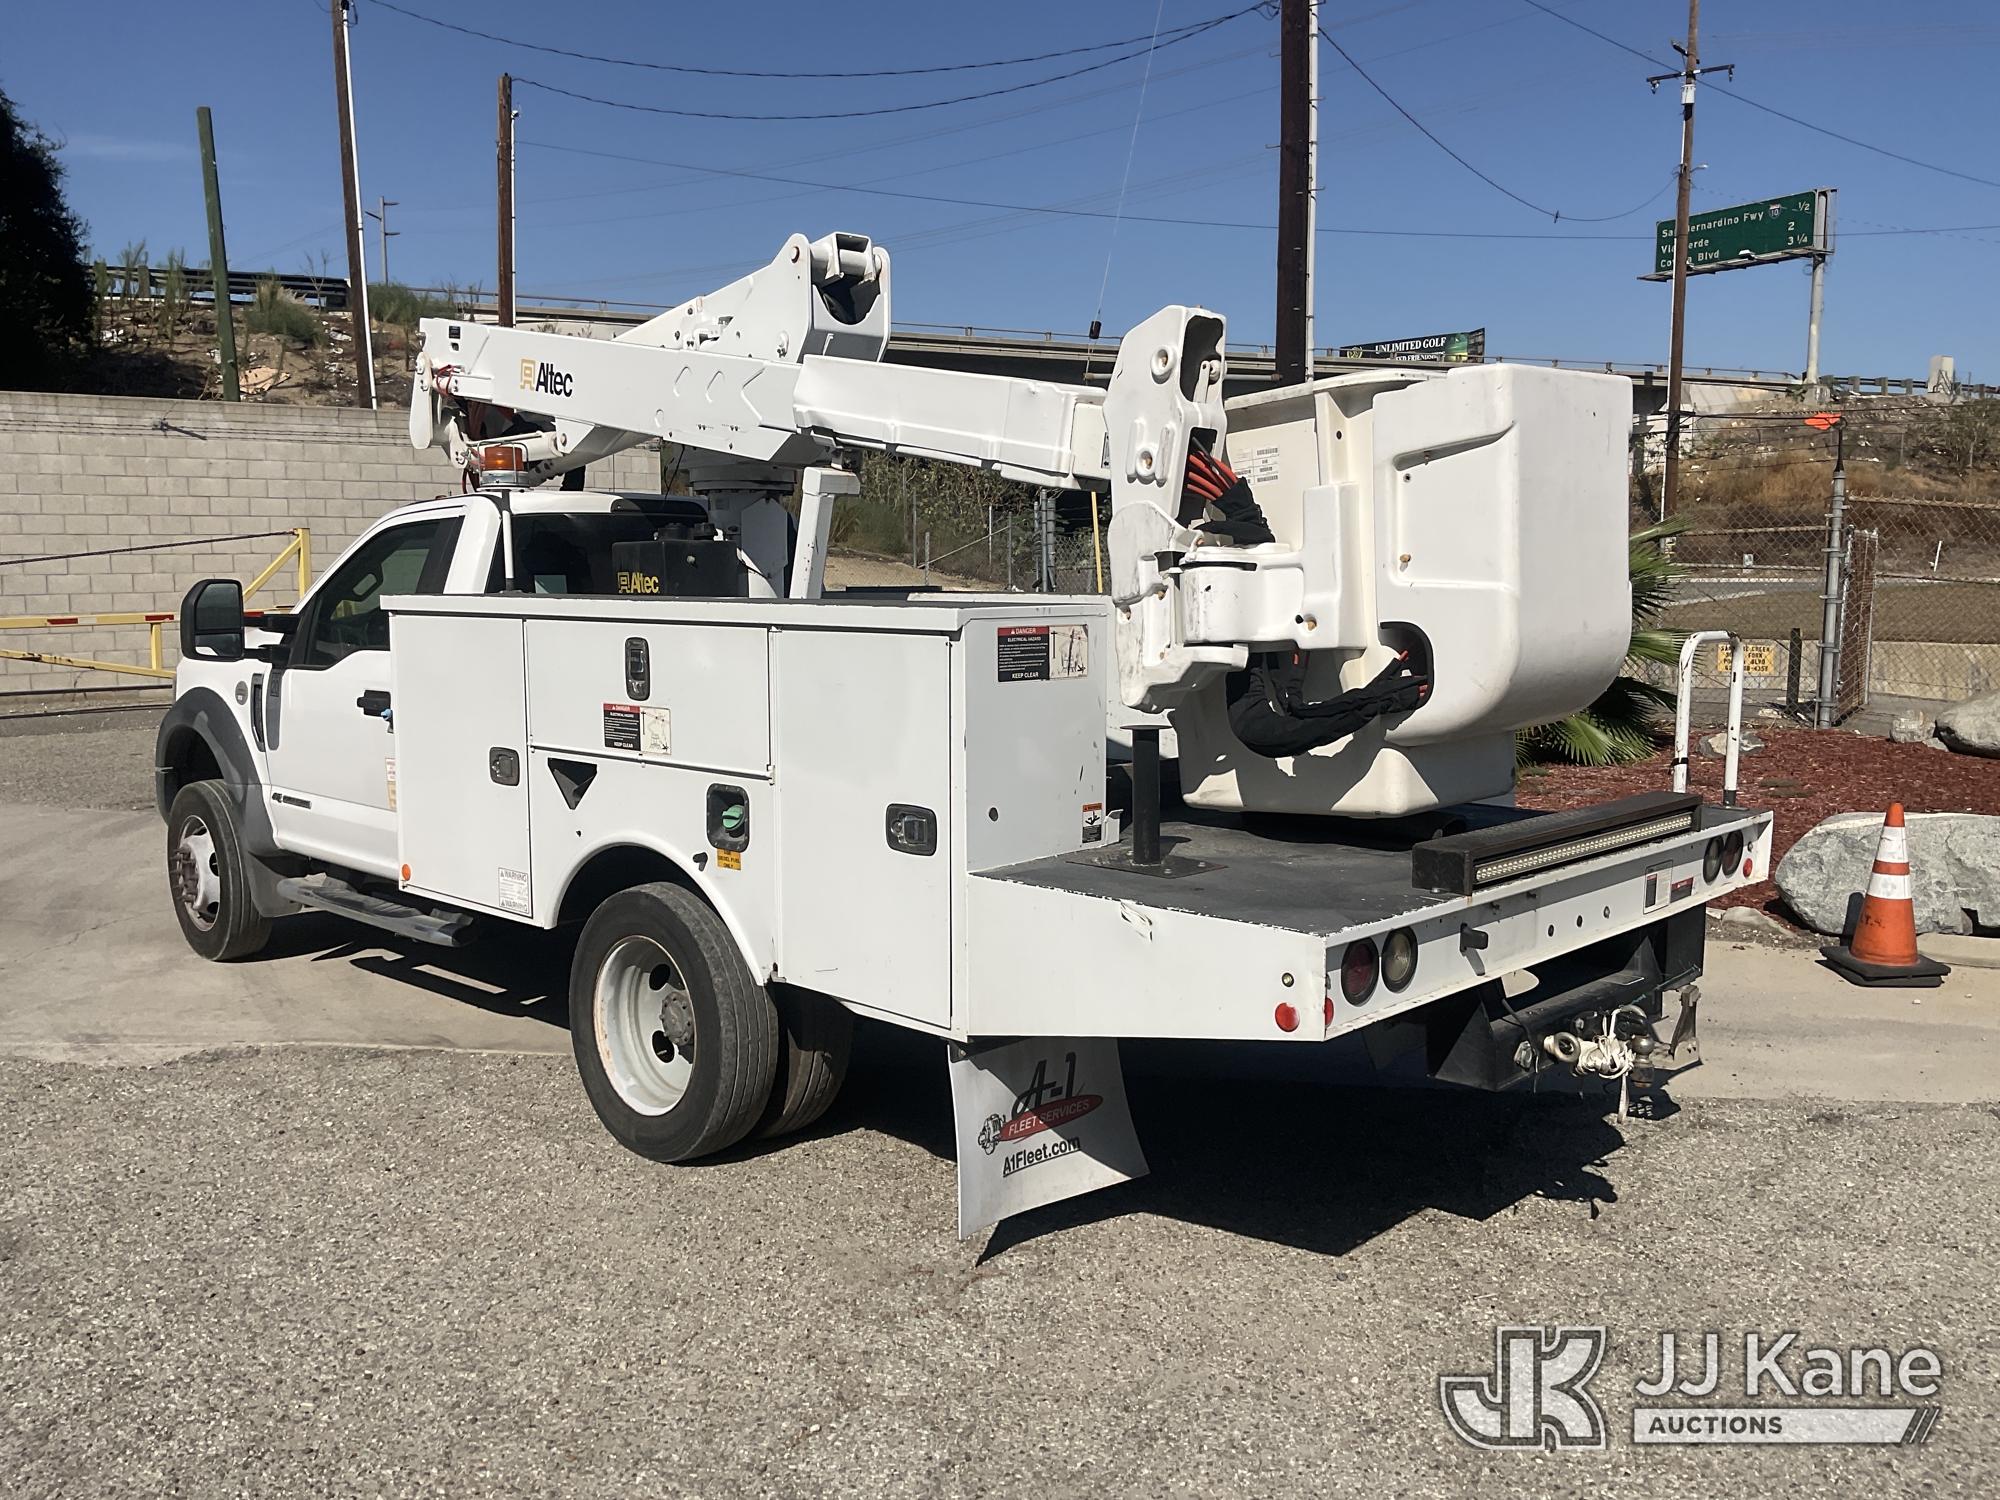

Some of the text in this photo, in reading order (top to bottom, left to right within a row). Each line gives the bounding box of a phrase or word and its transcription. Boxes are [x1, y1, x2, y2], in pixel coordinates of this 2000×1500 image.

[1662, 229, 1674, 238] Sa
[1743, 211, 1763, 222] Fwy
[1688, 238, 1709, 249] erde
[1787, 221, 1795, 231] 2
[1698, 249, 1720, 261] Blvd
[1787, 236, 1794, 245] 3
[1375, 337, 1447, 354] UNLIMITED GOLF
[535, 362, 573, 397] Altec
[630, 572, 659, 594] Altec
[1015, 627, 1037, 635] DANGER
[1011, 1052, 1077, 1119] A-1
[1008, 1100, 1090, 1136] FLEET SERVICES
[1003, 1136, 1081, 1176] A1Fleet.com
